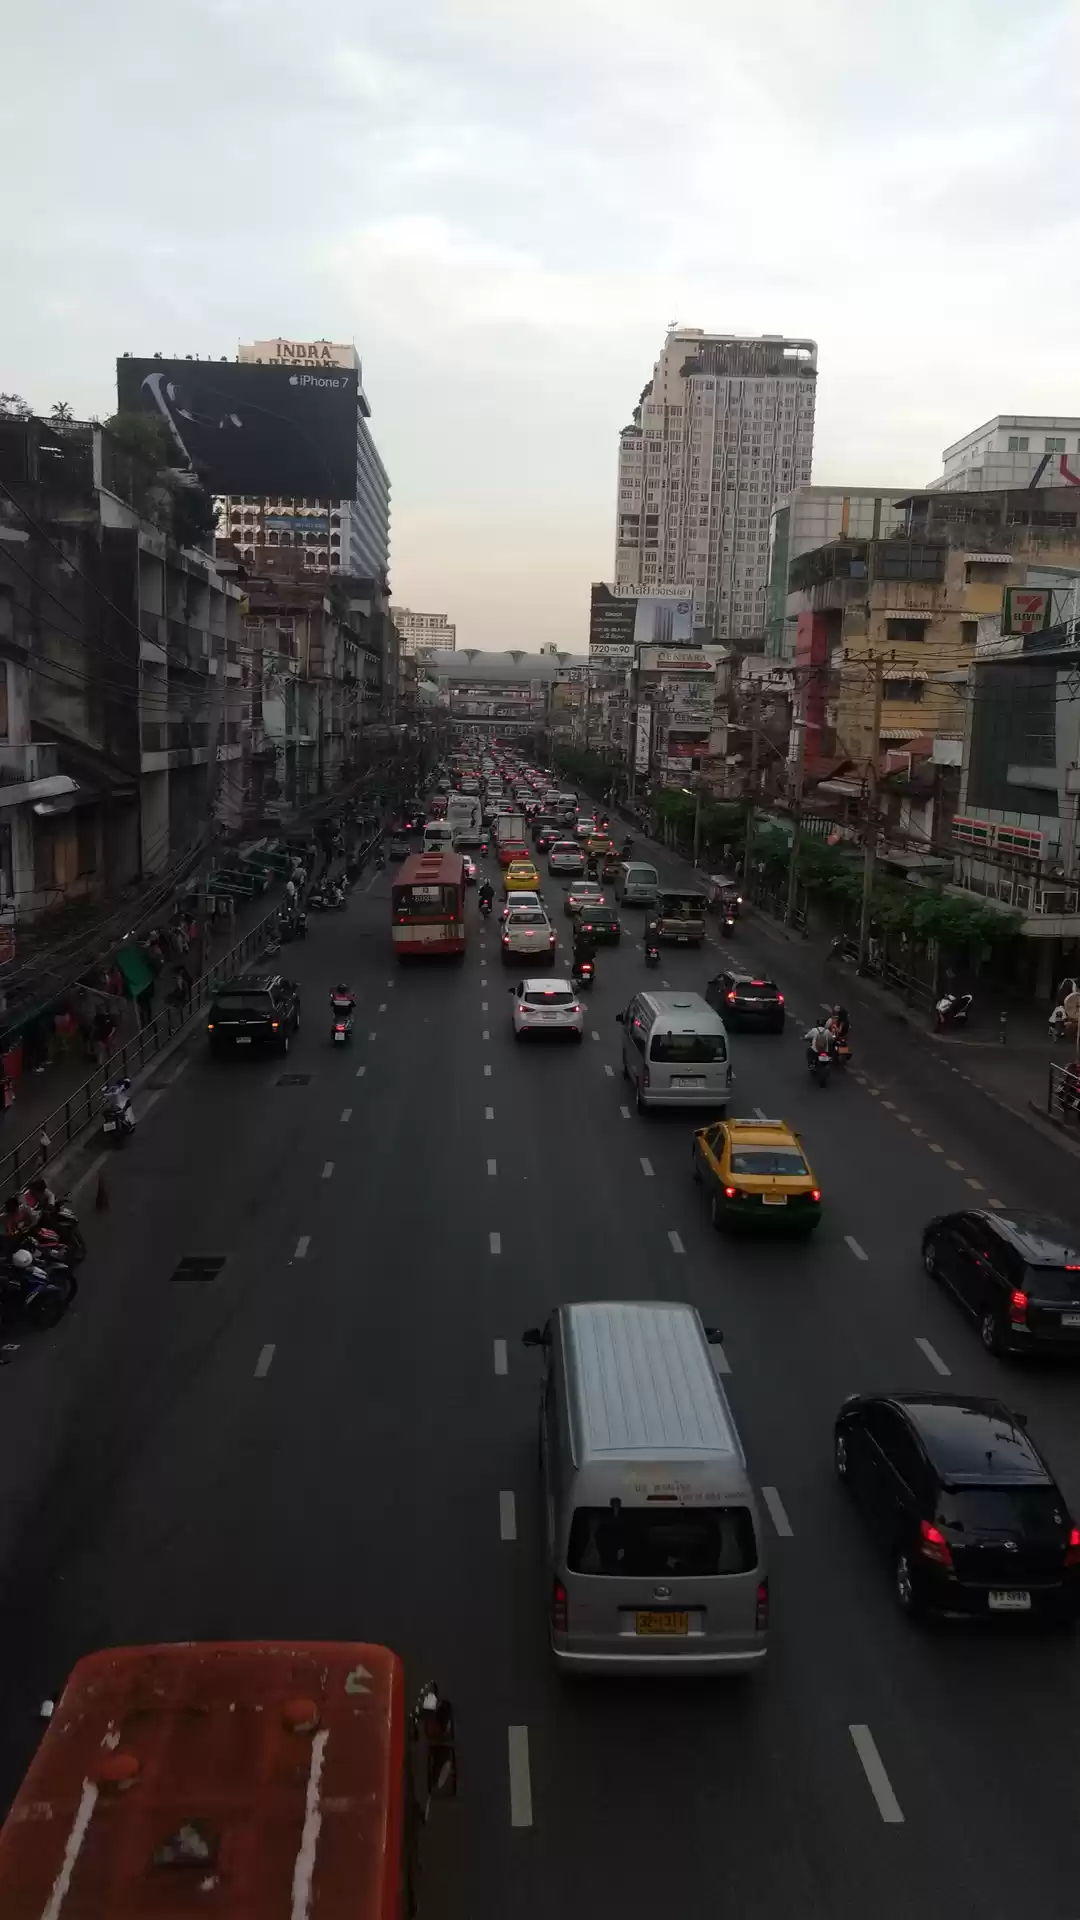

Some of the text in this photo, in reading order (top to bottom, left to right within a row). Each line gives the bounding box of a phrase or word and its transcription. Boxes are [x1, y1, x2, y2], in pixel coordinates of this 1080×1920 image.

[276, 343, 332, 359] INDRA
[300, 374, 349, 389] iPhone 7
[590, 645, 610, 653] 1720
[620, 645, 630, 653] 90
[658, 652, 707, 661] CENTARA
